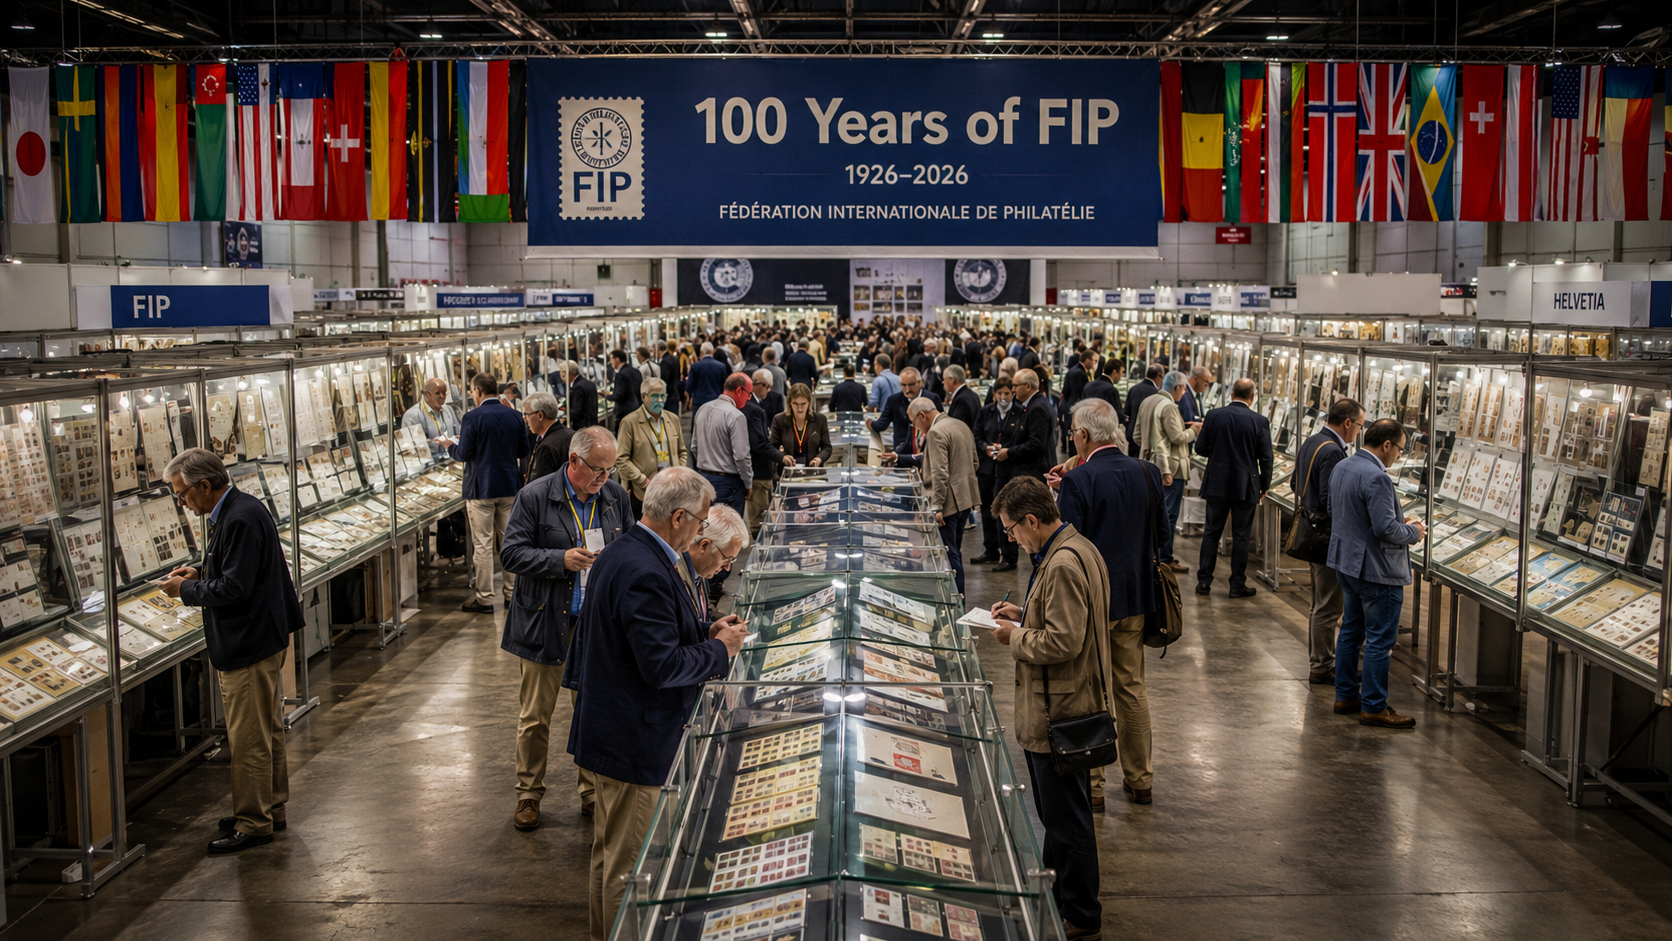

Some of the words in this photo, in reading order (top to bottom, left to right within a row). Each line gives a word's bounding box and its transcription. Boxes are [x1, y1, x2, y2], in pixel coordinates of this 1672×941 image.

[694, 96, 788, 145] 100
[804, 97, 949, 145] Years
[966, 95, 1021, 145] of
[1038, 98, 1120, 145] FIP
[573, 171, 632, 203] FIP
[719, 201, 822, 219] FÉDÉRATION
[828, 205, 970, 220] INTERNATIONALE
[976, 205, 998, 220] DE
[1003, 201, 1095, 220] PHILATÉLIE
[132, 294, 171, 319] FIP
[1553, 292, 1606, 311] HELVETIA
